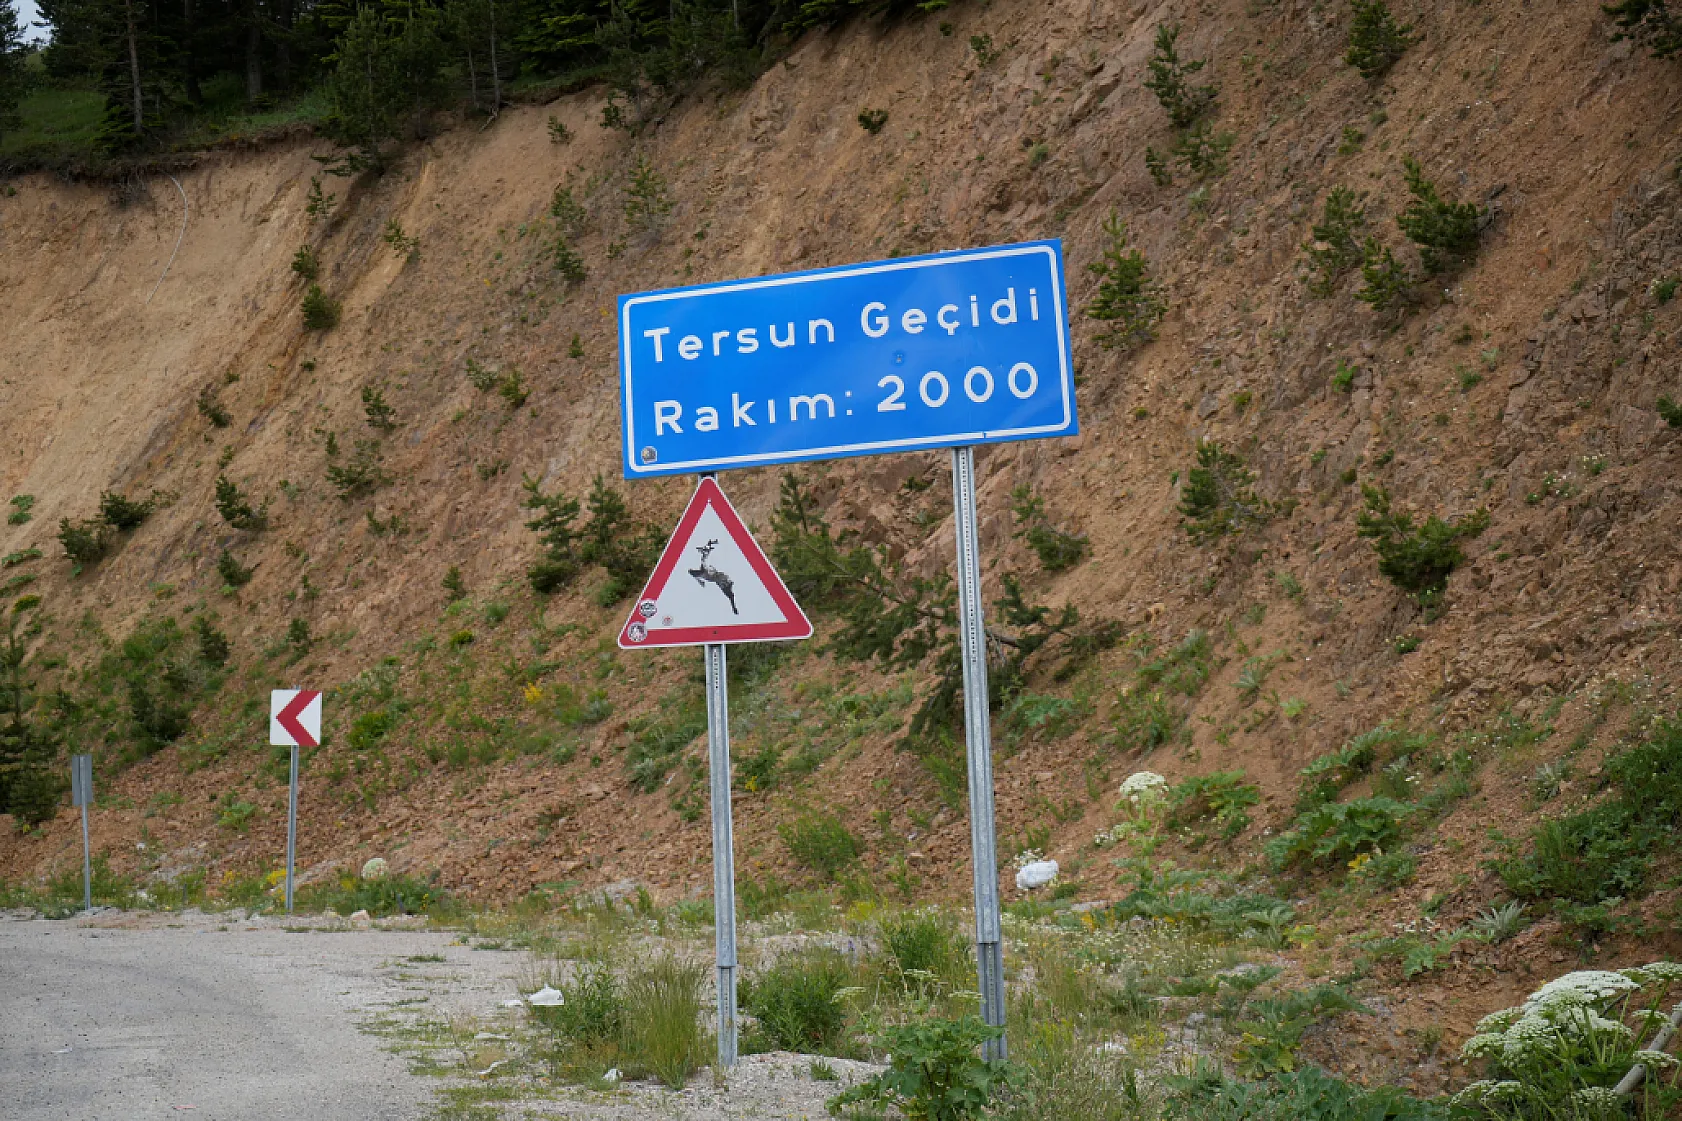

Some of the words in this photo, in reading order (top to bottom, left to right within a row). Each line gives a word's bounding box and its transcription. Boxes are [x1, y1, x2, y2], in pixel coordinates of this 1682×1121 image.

[644, 319, 834, 361] Tersun
[861, 288, 1038, 337] Geçidi
[654, 391, 852, 435] Rakım:
[878, 363, 1038, 412] 2000
